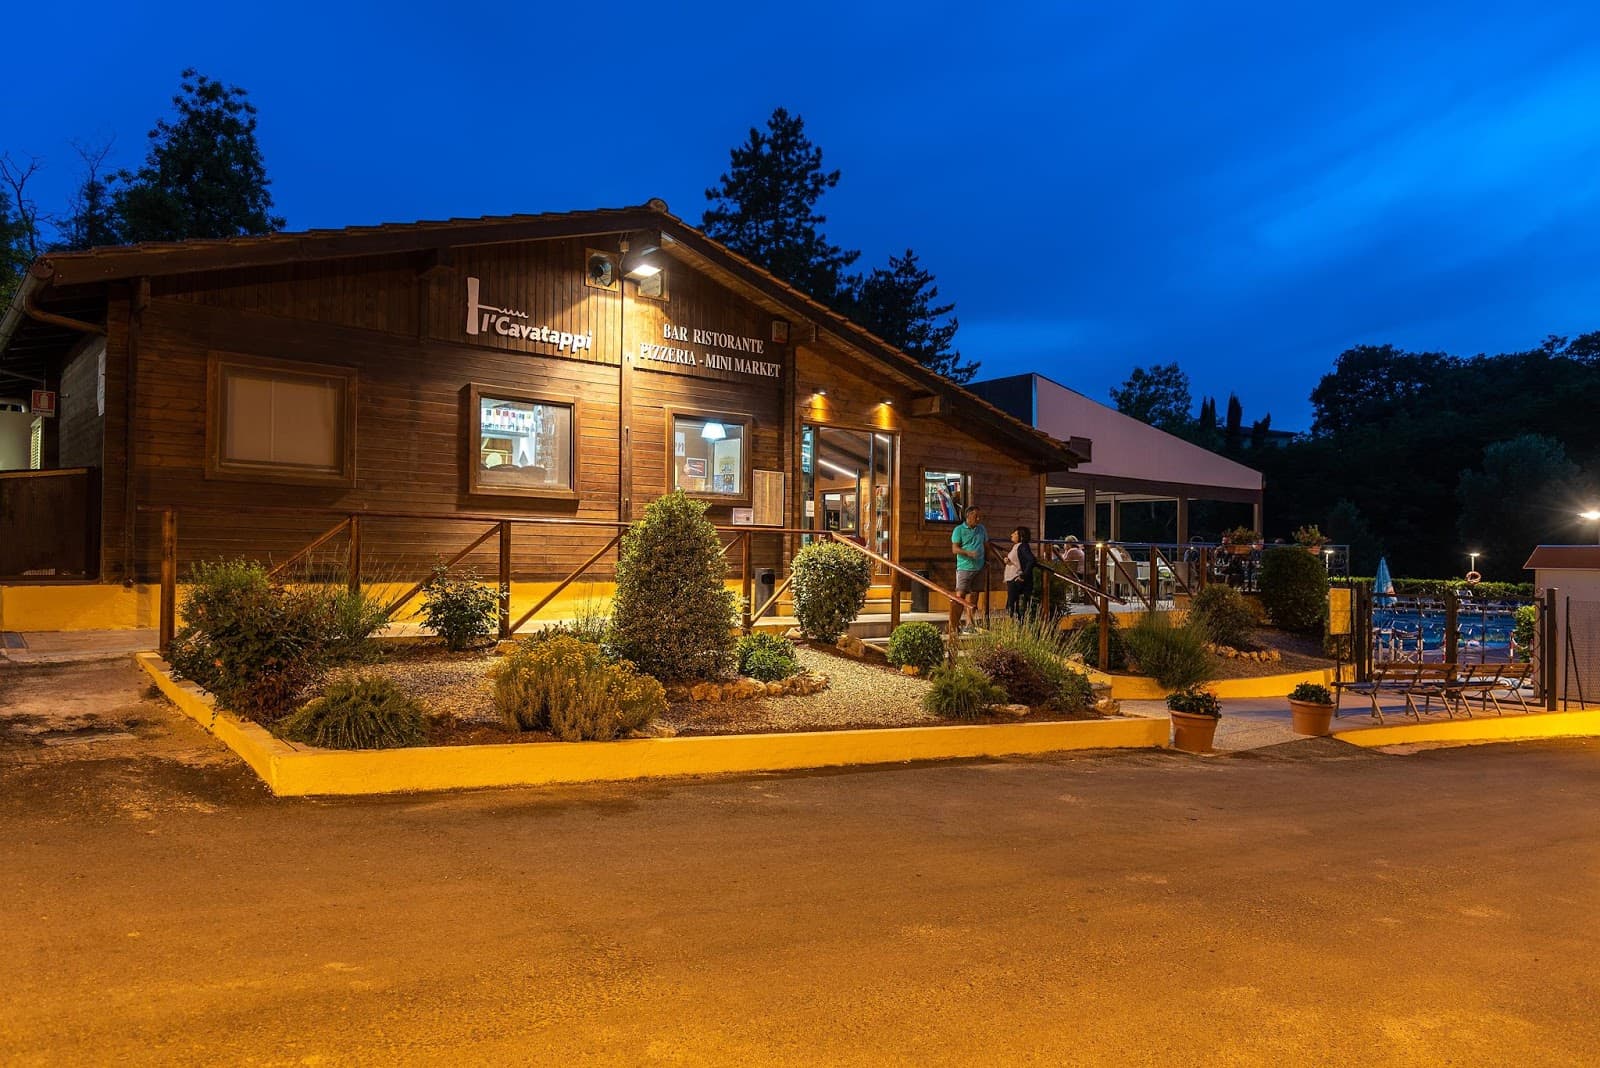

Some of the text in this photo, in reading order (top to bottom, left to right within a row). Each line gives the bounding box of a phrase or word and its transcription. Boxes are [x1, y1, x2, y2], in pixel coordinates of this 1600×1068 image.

[664, 323, 764, 354] BAR RISTORANTE
[640, 343, 696, 366] PIZZERIA
[705, 353, 732, 371] MINI
[734, 357, 781, 378] MARKET
